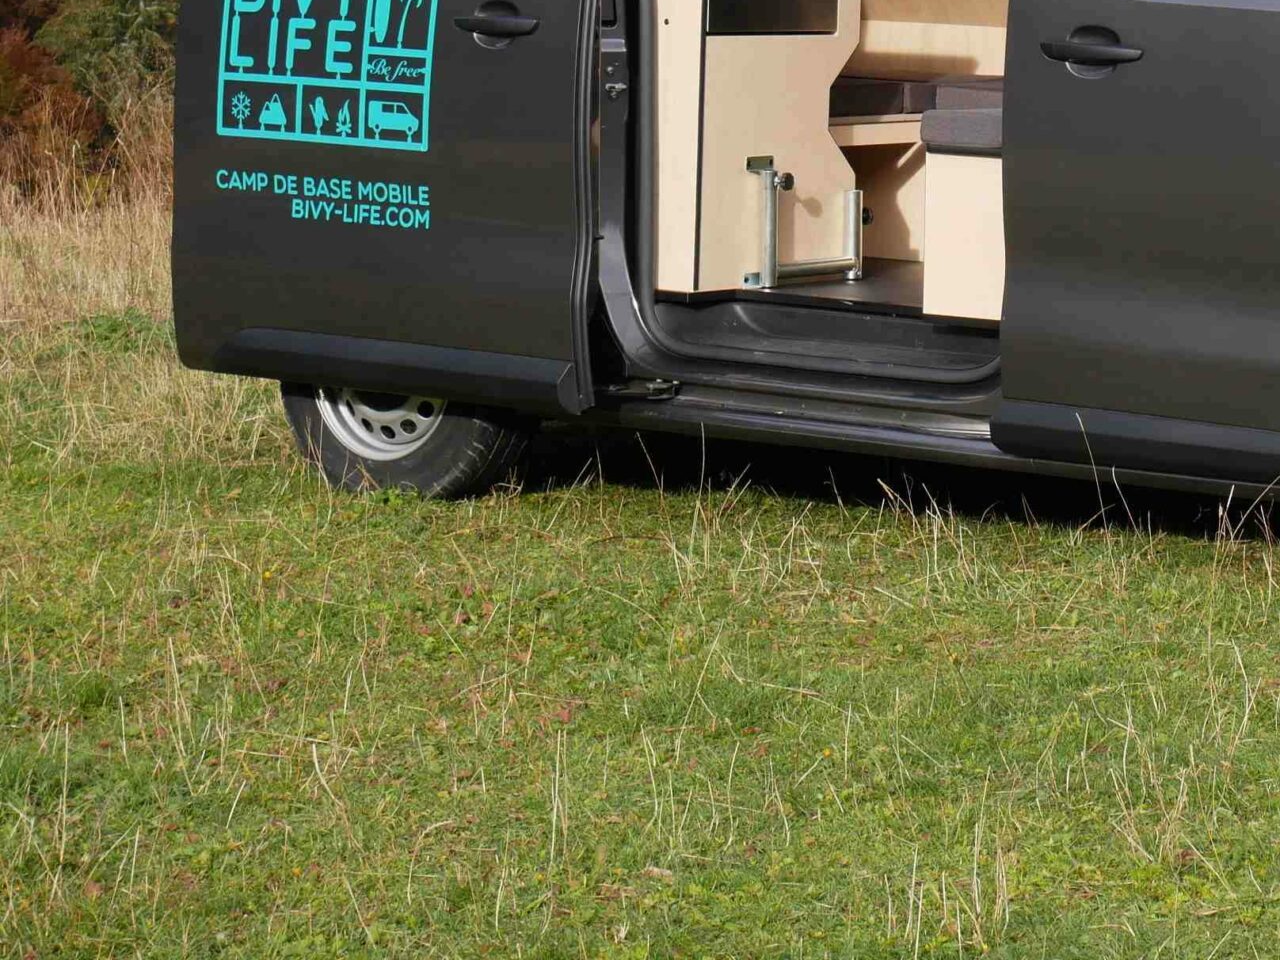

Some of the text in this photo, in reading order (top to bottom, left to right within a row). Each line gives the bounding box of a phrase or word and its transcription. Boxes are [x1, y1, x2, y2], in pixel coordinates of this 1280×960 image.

[229, 15, 357, 74] LIFE
[369, 57, 421, 82] Be free
[216, 169, 430, 206] CAMP DE BASE MOBILE
[291, 198, 430, 229] BIVY-LIFE.COM
